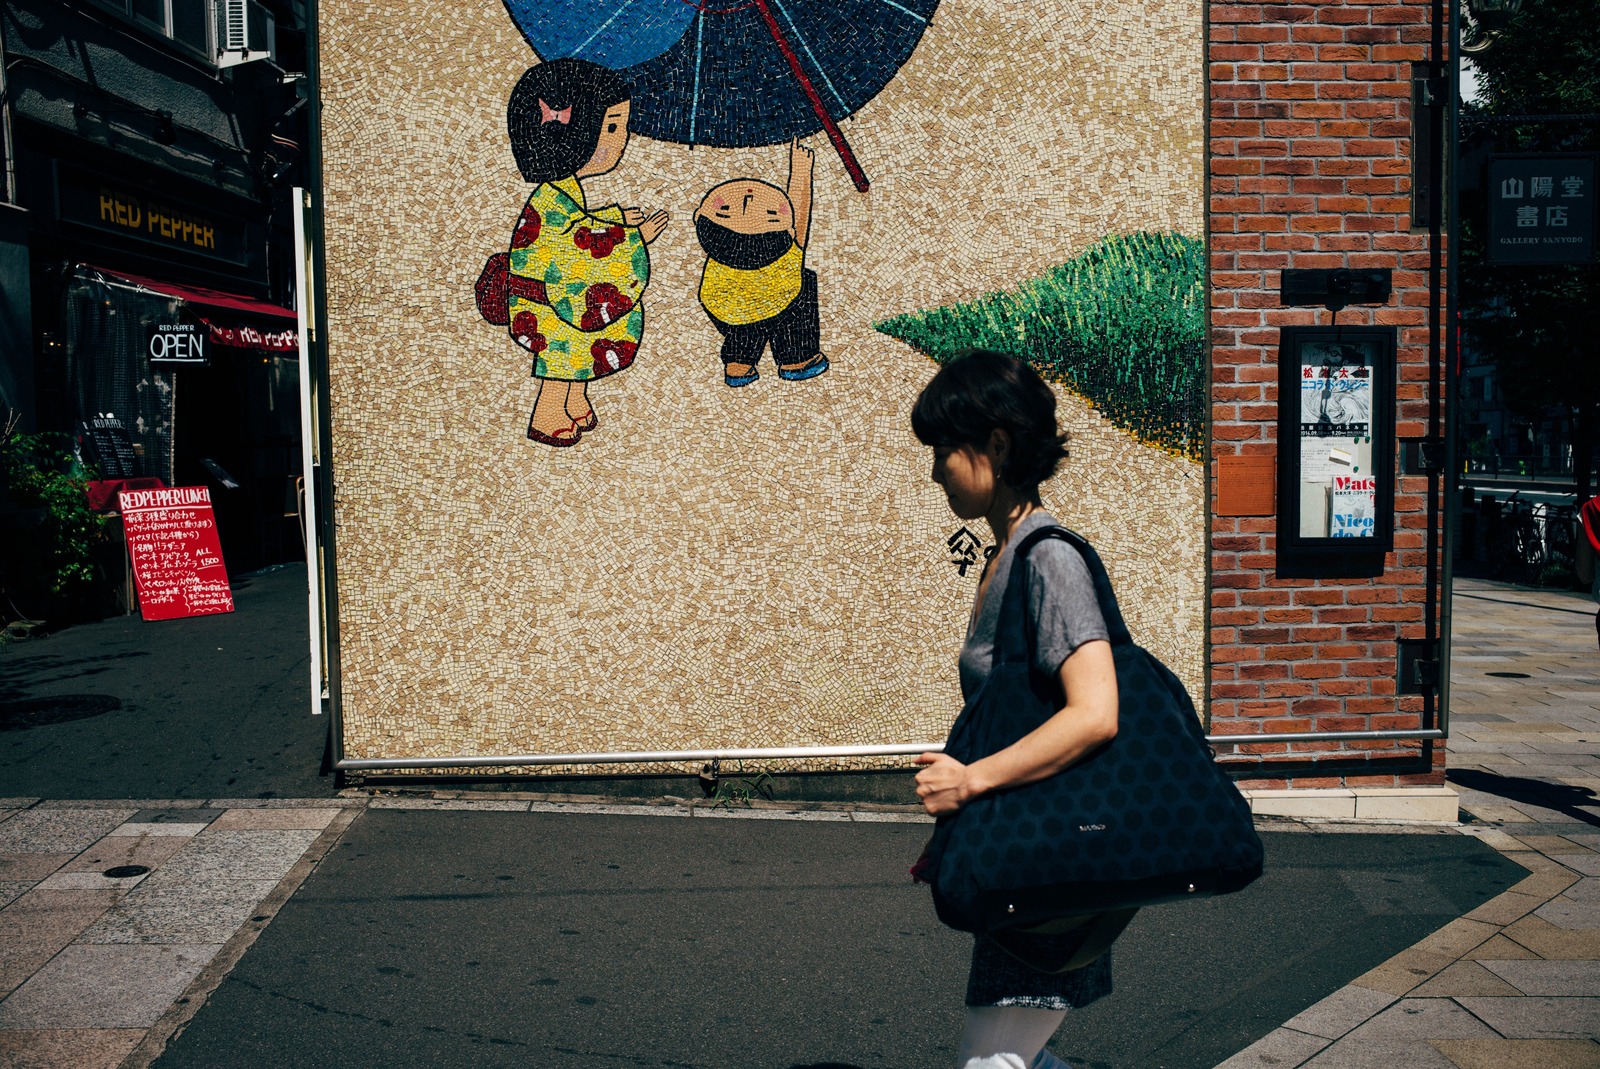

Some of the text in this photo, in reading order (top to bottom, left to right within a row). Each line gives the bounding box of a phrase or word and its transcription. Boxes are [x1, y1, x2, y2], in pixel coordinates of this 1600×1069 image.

[1501, 175, 1584, 199] 山陽堂
[98, 185, 216, 250] RED PEPPER
[1516, 205, 1569, 228] 書店
[1542, 236, 1583, 244] SANYODO
[172, 324, 195, 332] PEPPER
[150, 333, 203, 358] OPEN
[196, 547, 213, 557] ALL
